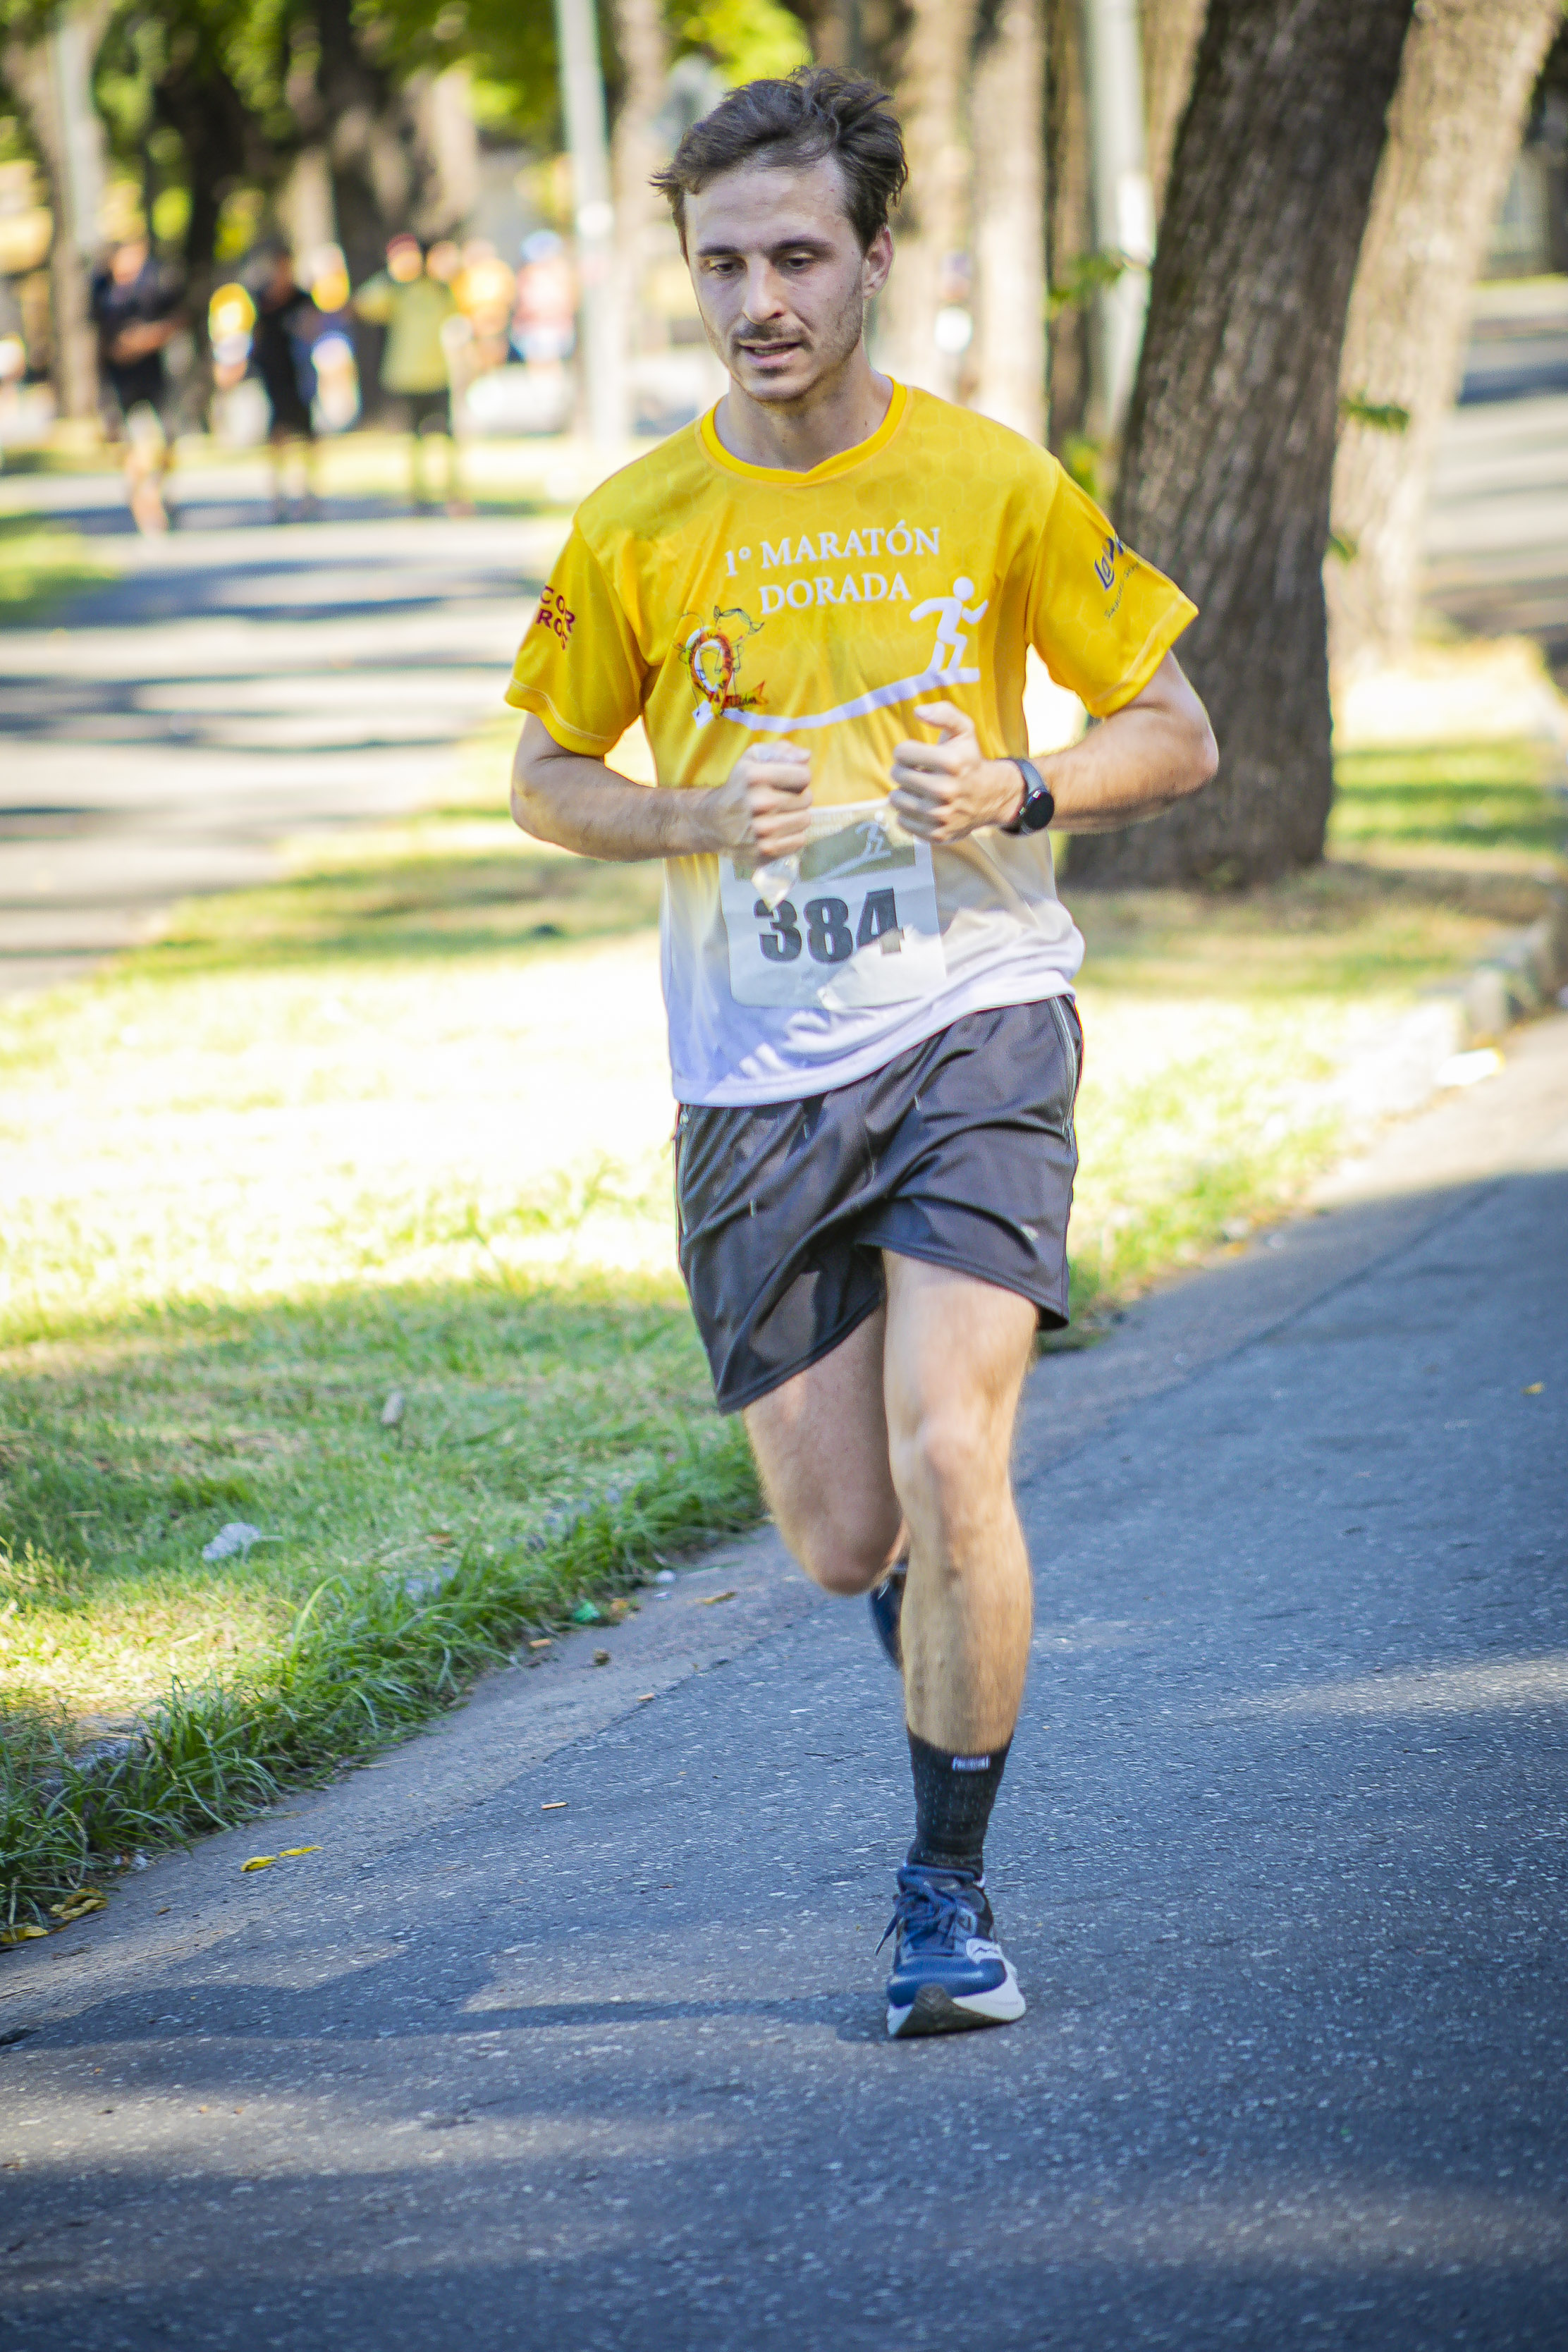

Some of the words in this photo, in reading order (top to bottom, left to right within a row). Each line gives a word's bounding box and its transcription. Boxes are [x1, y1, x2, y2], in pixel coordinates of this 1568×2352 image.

[759, 519, 941, 569] MARATÓN
[759, 572, 911, 615] DORADA
[753, 886, 905, 964] 384
